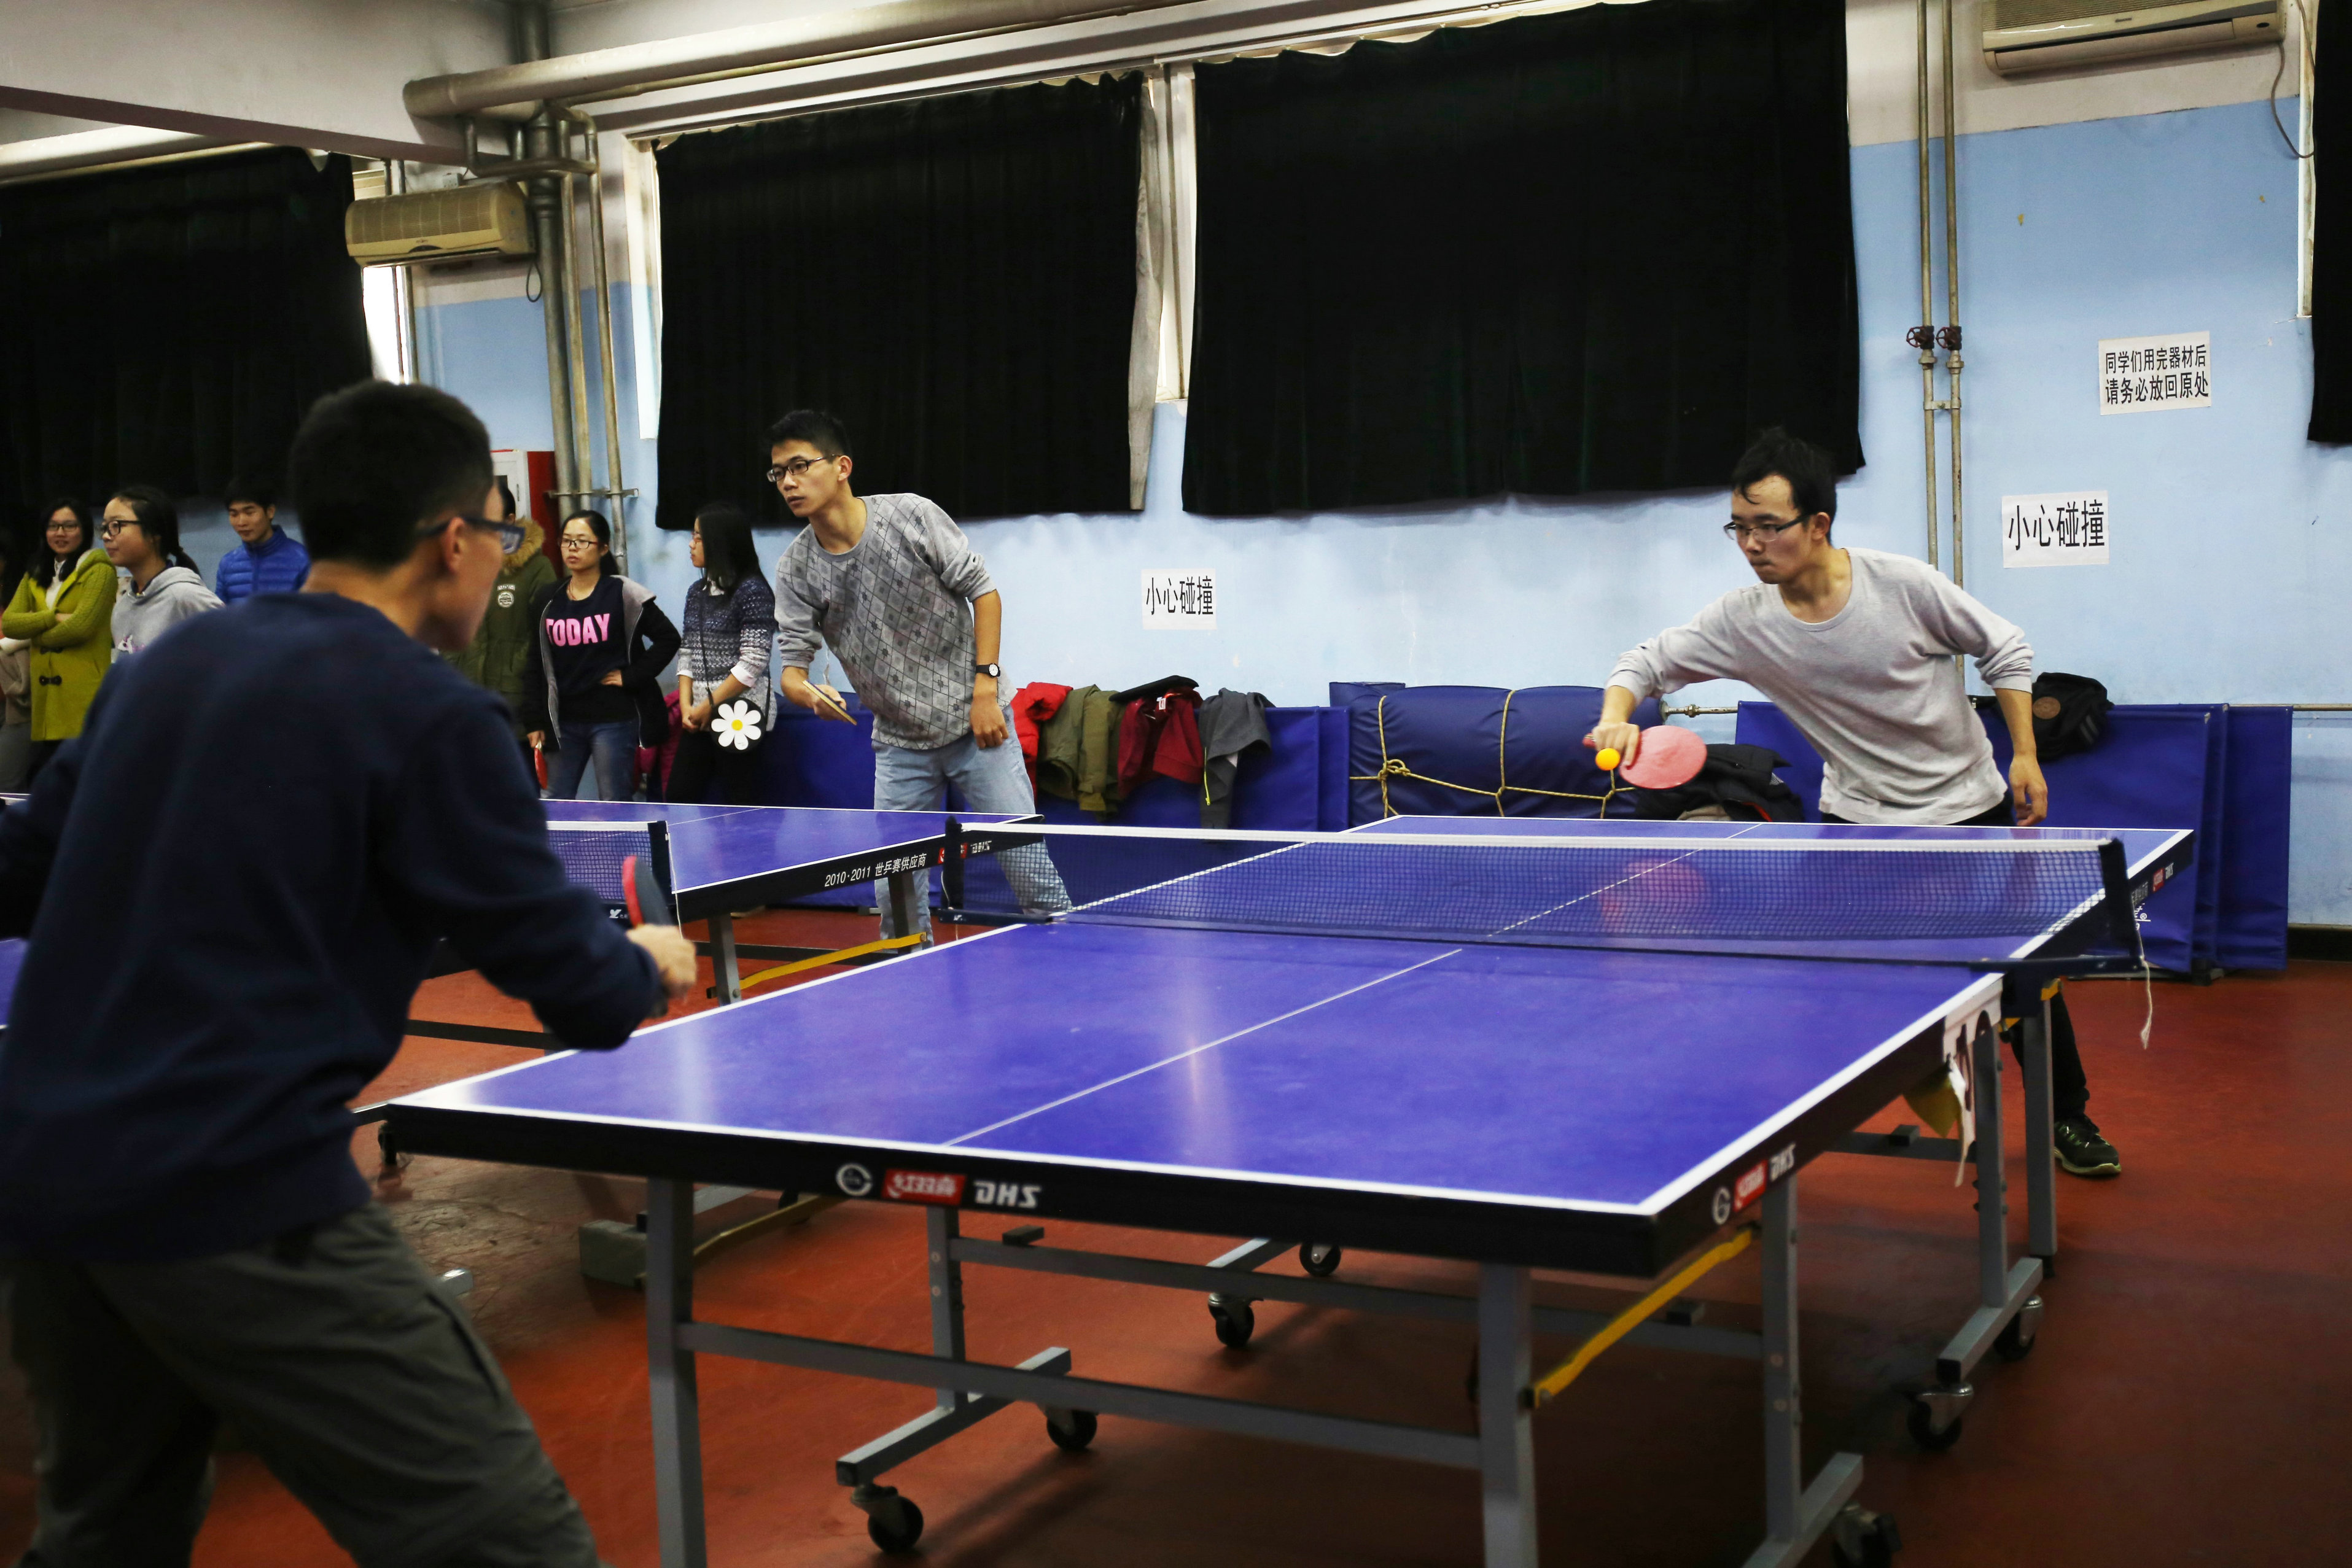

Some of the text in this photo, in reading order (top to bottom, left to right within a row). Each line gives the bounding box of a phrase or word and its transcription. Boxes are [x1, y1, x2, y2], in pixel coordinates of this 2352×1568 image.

[2105, 344, 2206, 375] 同学们用完器材后
[2105, 371, 2209, 405] 请务必放回原处
[2008, 499, 2105, 551] 小心碰撞
[1146, 575, 1214, 615] 小心碰撞
[545, 613, 610, 647] TODAY
[874, 853, 927, 877] 世乒赛供应商
[973, 1179, 1042, 1209] DHS
